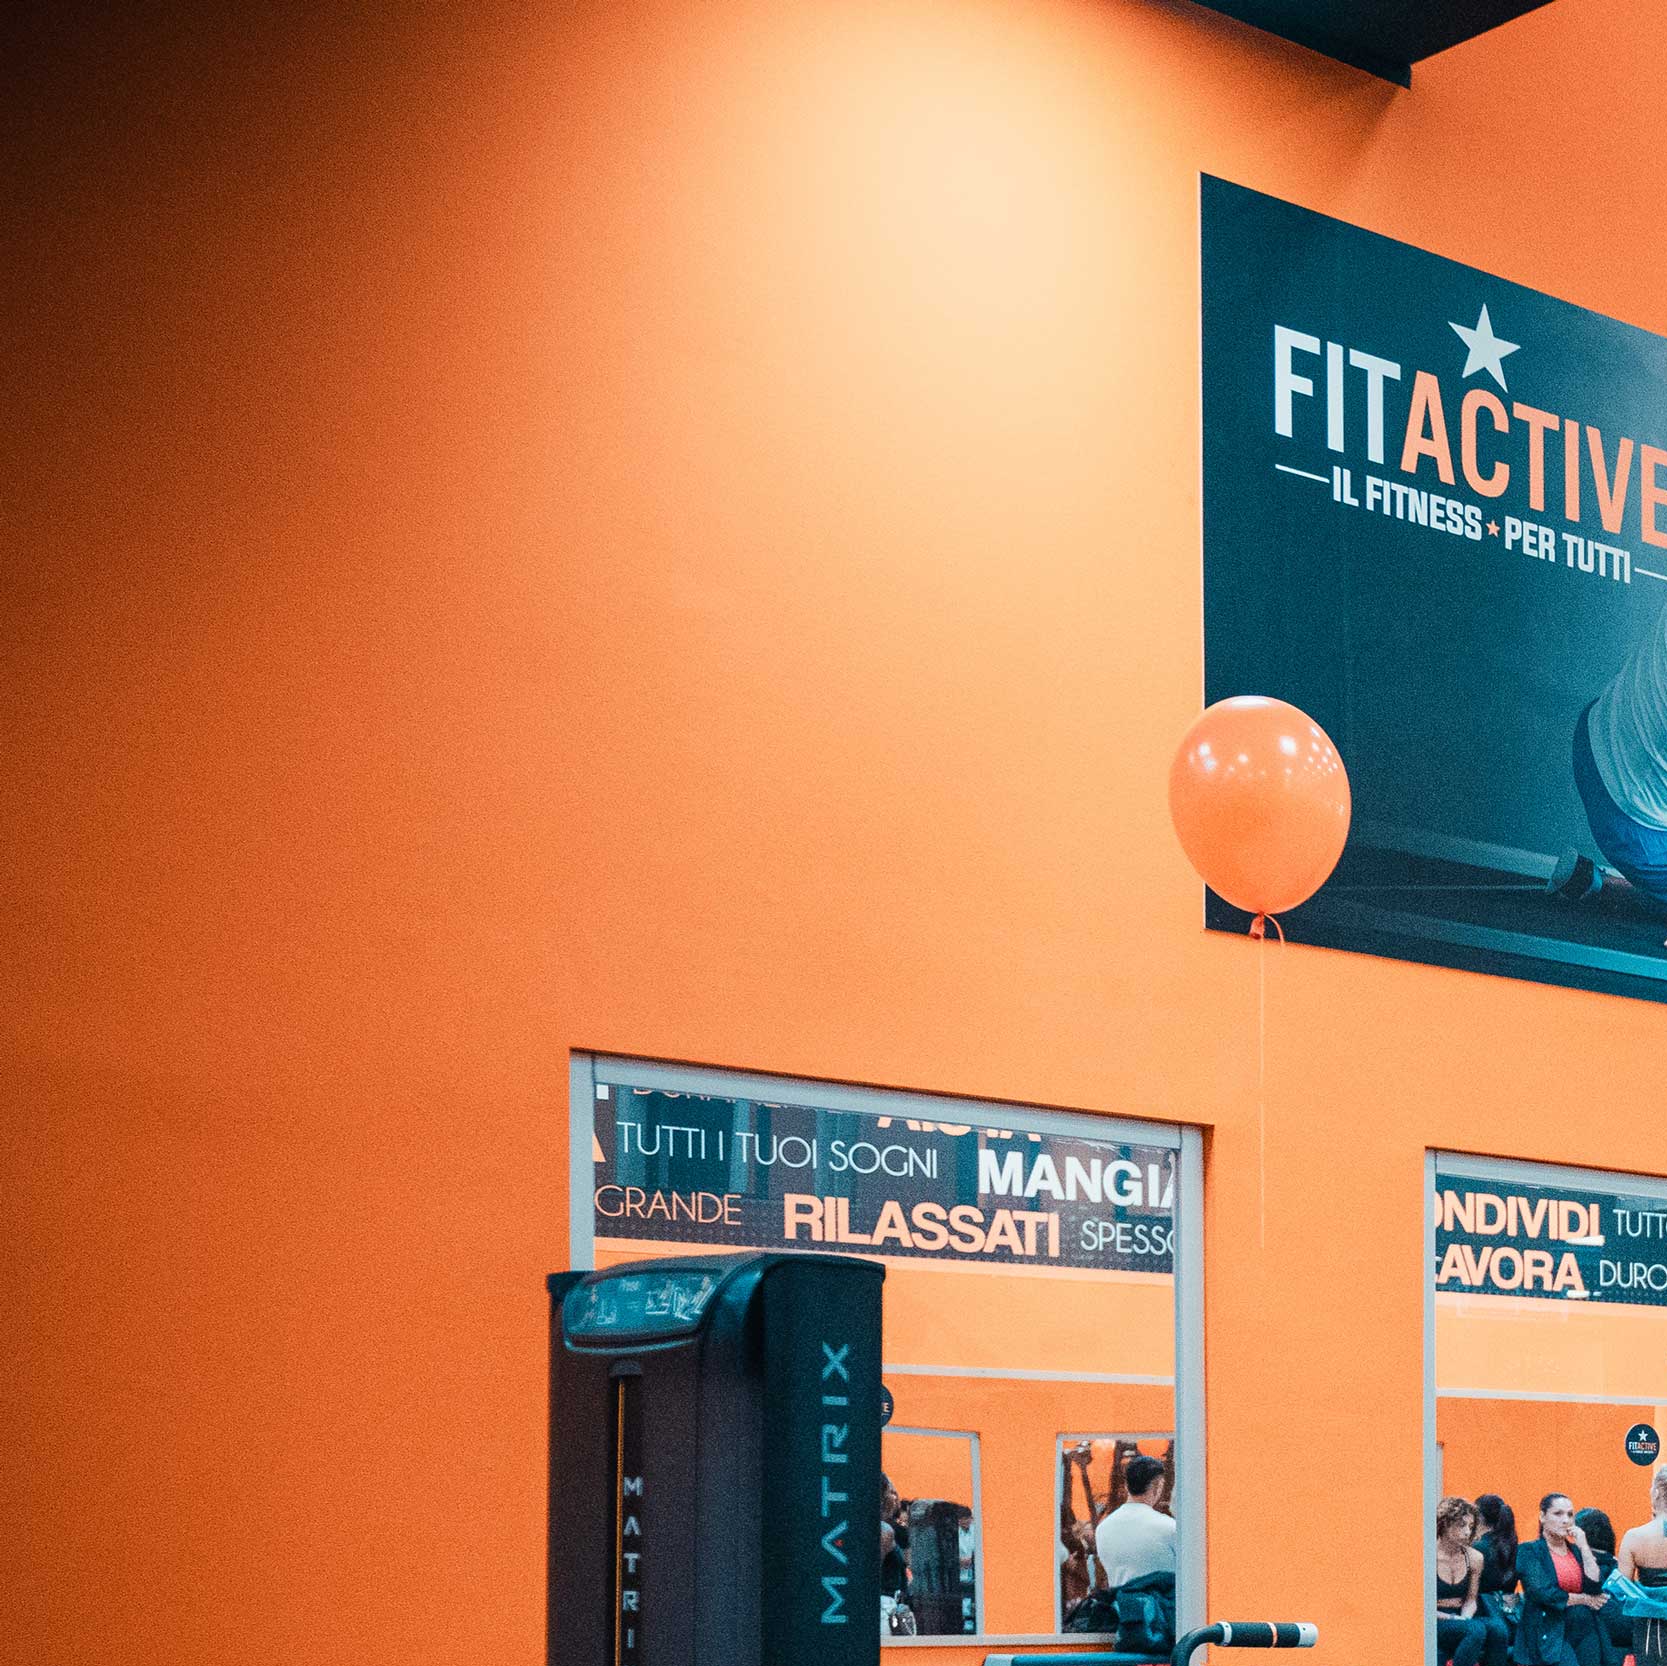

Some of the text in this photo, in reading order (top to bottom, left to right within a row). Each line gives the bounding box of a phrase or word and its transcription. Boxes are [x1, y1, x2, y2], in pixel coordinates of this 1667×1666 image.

[1333, 465, 1631, 584] IL FITNESS PER TUTTI
[616, 1121, 706, 1160] TUTTI
[735, 1131, 817, 1169] TUOI
[828, 1140, 938, 1179] SOGNI
[595, 1184, 742, 1226] GRANDE
[784, 1193, 1060, 1258] RILASSATI
[1435, 1189, 1602, 1246] NDIVIDI
[1436, 1243, 1585, 1292] AVORA
[821, 1341, 849, 1625] MATRIX
